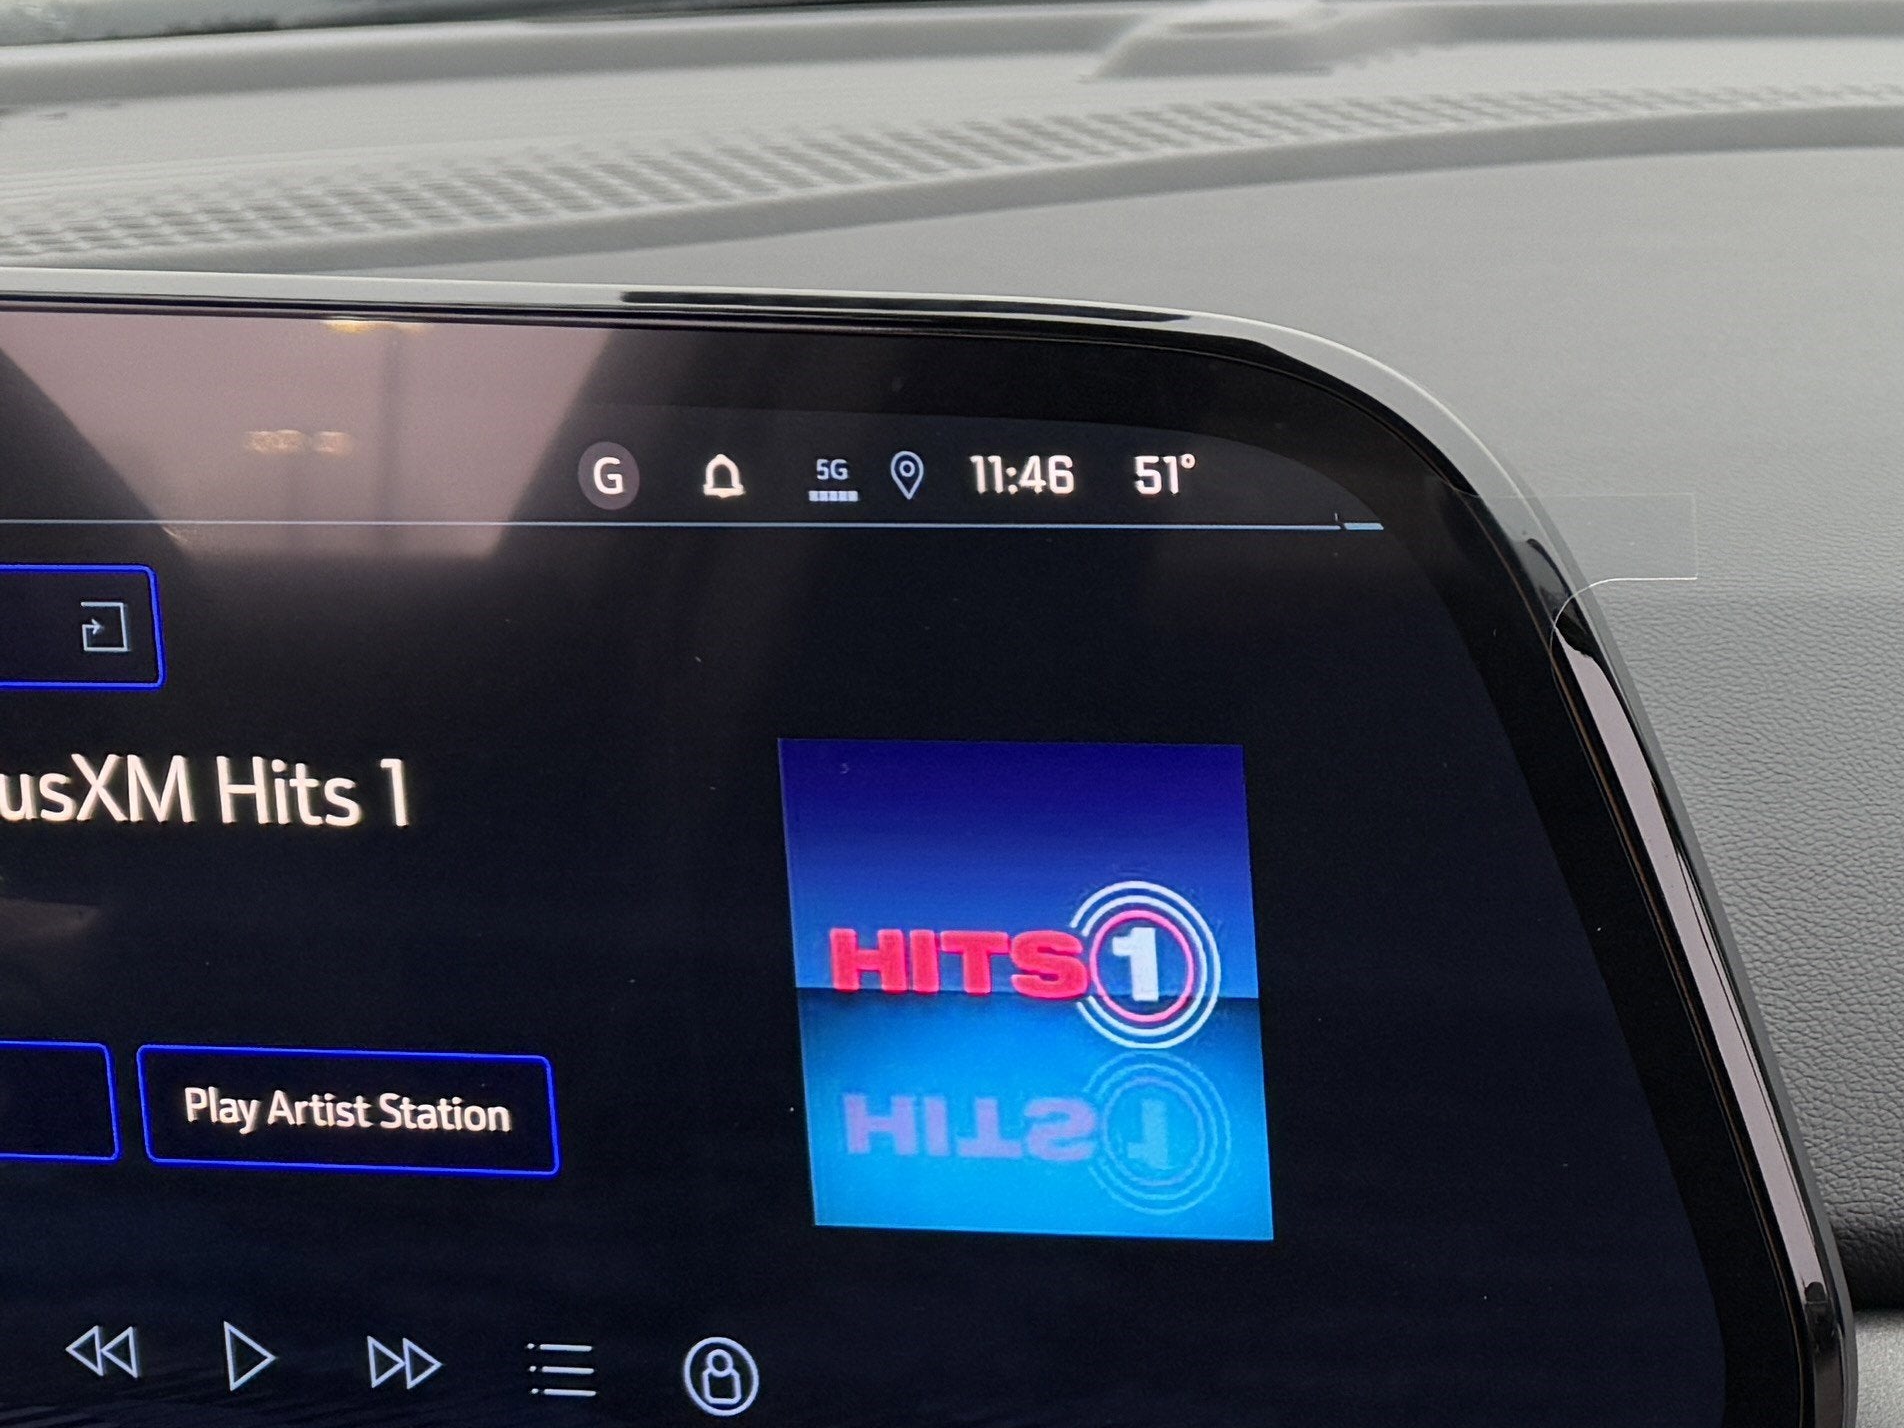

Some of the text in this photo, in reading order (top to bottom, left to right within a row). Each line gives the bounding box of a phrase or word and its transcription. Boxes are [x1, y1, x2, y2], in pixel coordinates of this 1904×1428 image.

[593, 456, 625, 496] G
[816, 458, 849, 481] 5G
[969, 453, 1076, 496] 11:46
[1134, 452, 1196, 496] 51°
[216, 755, 363, 827] Hits
[379, 757, 411, 828] 1
[829, 925, 1160, 1003] HITS 1
[184, 1086, 512, 1136] Play Artist Station
